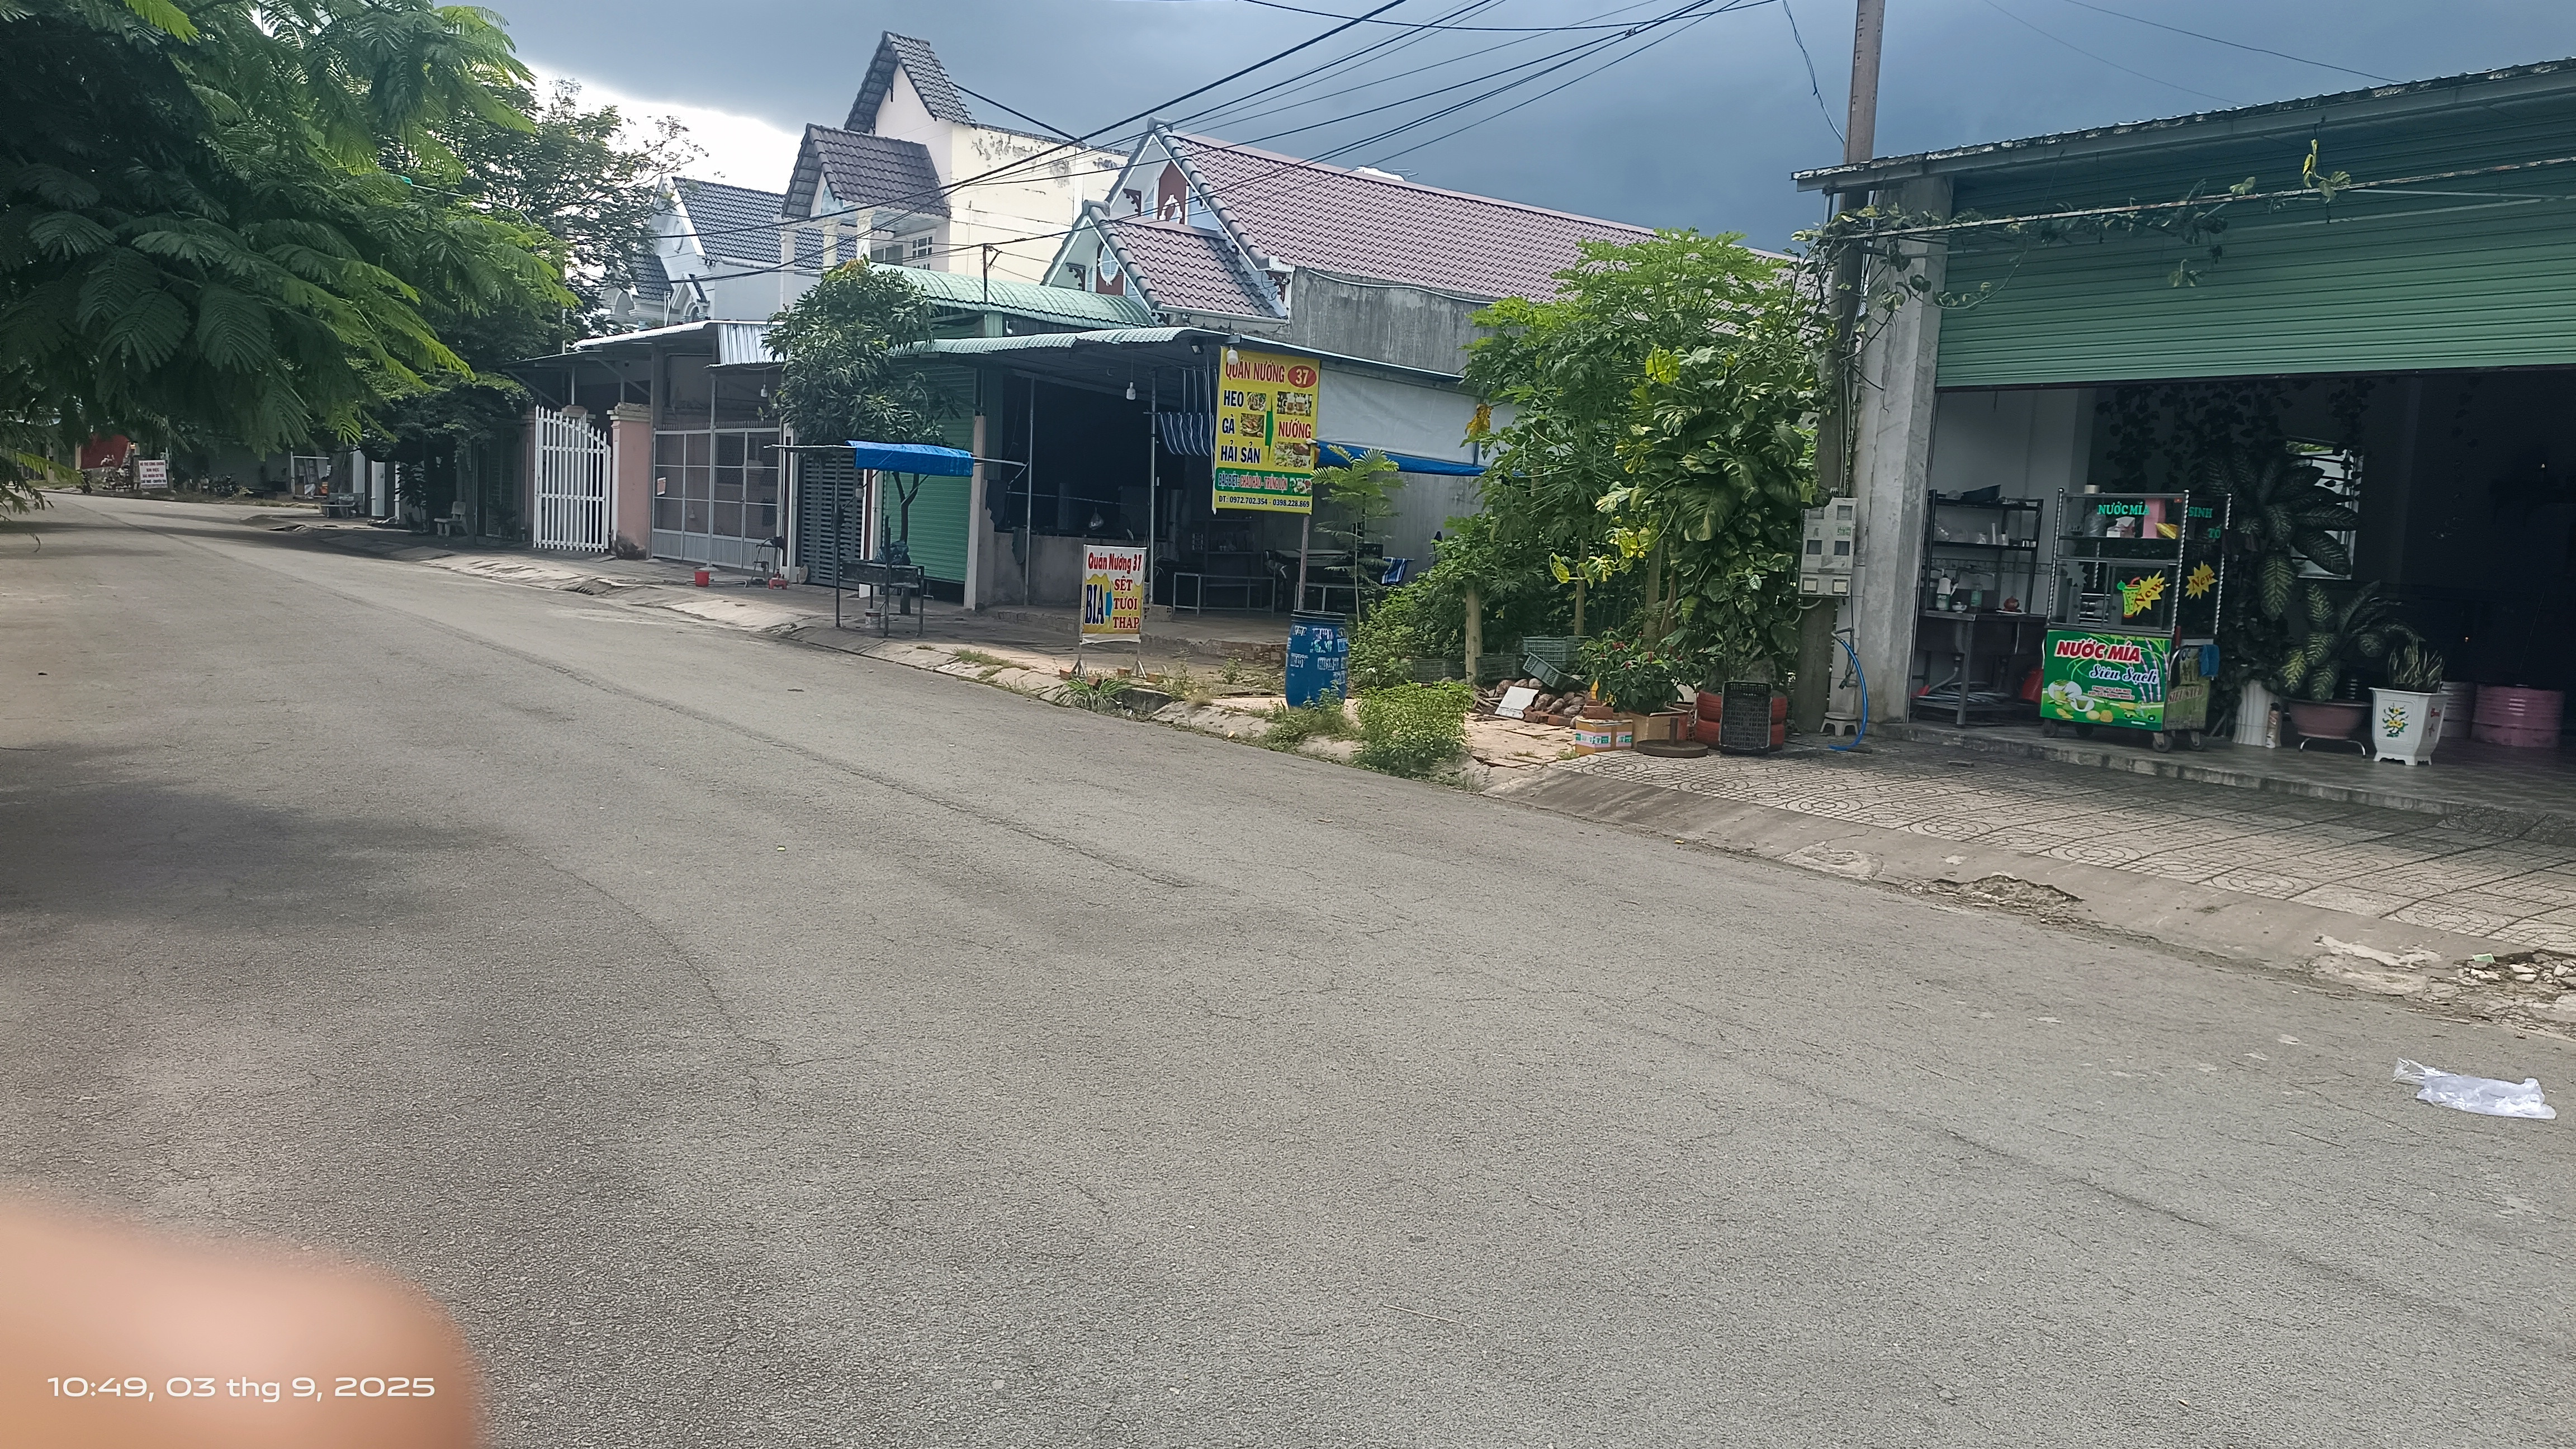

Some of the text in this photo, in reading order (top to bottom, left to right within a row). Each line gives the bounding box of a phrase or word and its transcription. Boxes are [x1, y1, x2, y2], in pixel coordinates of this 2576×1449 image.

[1225, 356, 1285, 383] QUÁN NƯỚNG
[1295, 368, 1309, 385] 37
[1223, 390, 1244, 408] HEO
[1222, 414, 1235, 434] GÀ
[1278, 418, 1311, 439] NƯỚNG
[1220, 439, 1261, 464] HẢI SẢN
[1230, 496, 1268, 505] 0972.702.354
[2097, 501, 2150, 515] NƯỚC MÍA
[2188, 506, 2213, 518] SINH
[1088, 552, 1142, 575] Quán Nướng 37
[1114, 575, 1133, 594] SỆT
[2191, 572, 2215, 590] New
[1085, 584, 1105, 624] BIA
[1113, 595, 1138, 610] TƯƠI
[2135, 581, 2162, 608] New
[1112, 613, 1140, 629] THÁP
[2056, 637, 2141, 662] NƯỚC MÍA
[2090, 664, 2158, 685] Siêu Sạch
